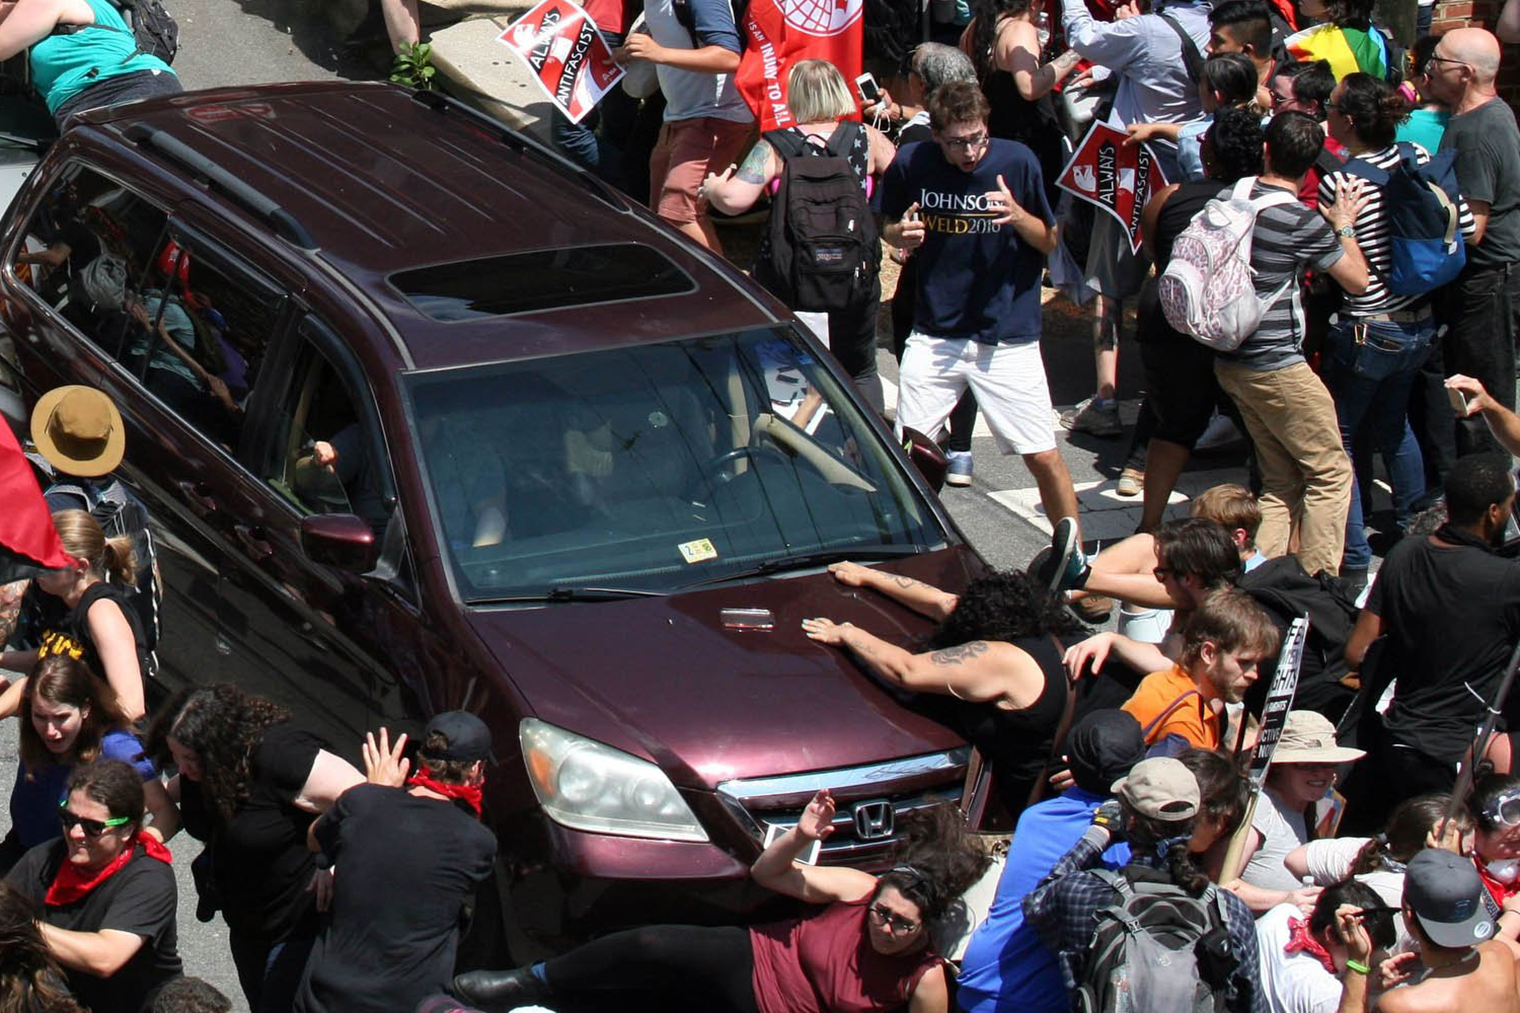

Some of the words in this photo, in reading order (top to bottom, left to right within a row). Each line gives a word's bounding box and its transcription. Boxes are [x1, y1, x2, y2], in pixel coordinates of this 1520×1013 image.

[530, 12, 560, 69] ALWAYS
[556, 22, 594, 105] ANTIFASCIST
[767, 82, 783, 100] TO
[1098, 146, 1115, 204] ALWAYS
[1129, 148, 1151, 237] ANTIFASCIST
